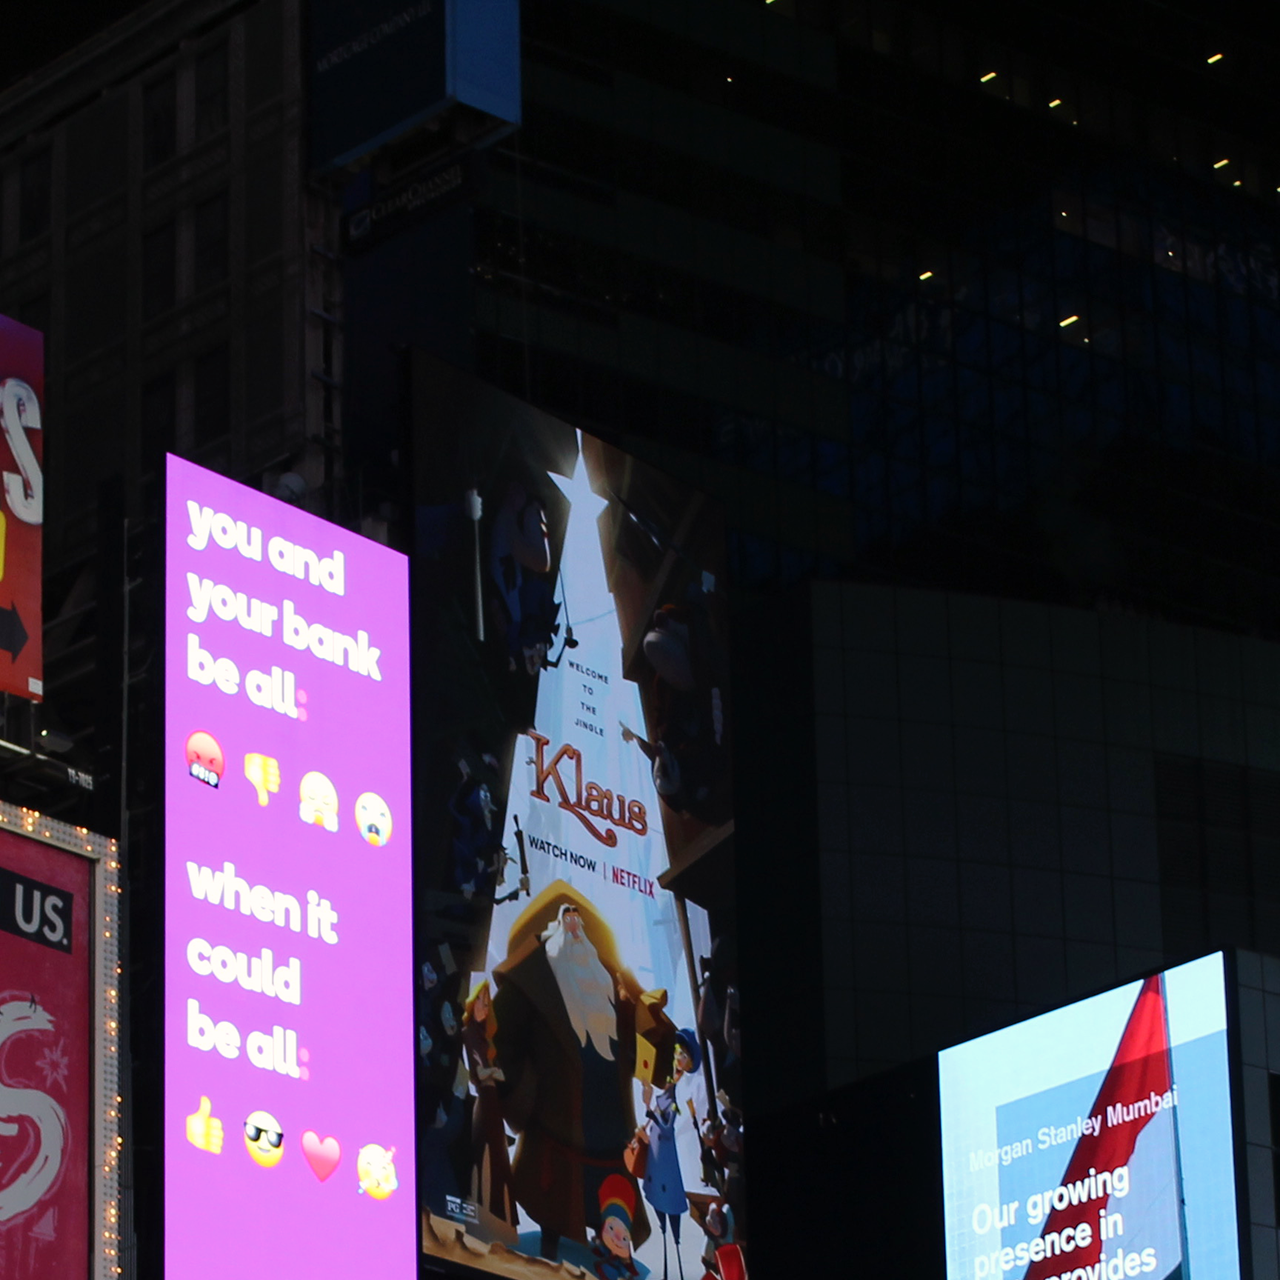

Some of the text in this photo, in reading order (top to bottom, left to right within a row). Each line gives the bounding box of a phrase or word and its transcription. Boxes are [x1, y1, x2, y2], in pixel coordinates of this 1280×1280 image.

[186, 499, 345, 596] you and
[186, 572, 382, 682] your bank
[187, 632, 241, 695] be
[567, 659, 609, 685] WELCOME
[582, 684, 594, 696] TO
[574, 717, 604, 737] JINGLE
[580, 700, 597, 716] THE
[528, 729, 648, 848] Klaus
[528, 835, 655, 899] WATCH NOW NETFLIX
[14, 883, 69, 946] US.
[186, 860, 339, 945] when it
[186, 937, 302, 1006] could
[186, 998, 241, 1060] be
[969, 1083, 1179, 1173] Morgan Stanley Mumbai
[971, 1163, 1132, 1236] Our growing
[1098, 1211, 1124, 1243] in
